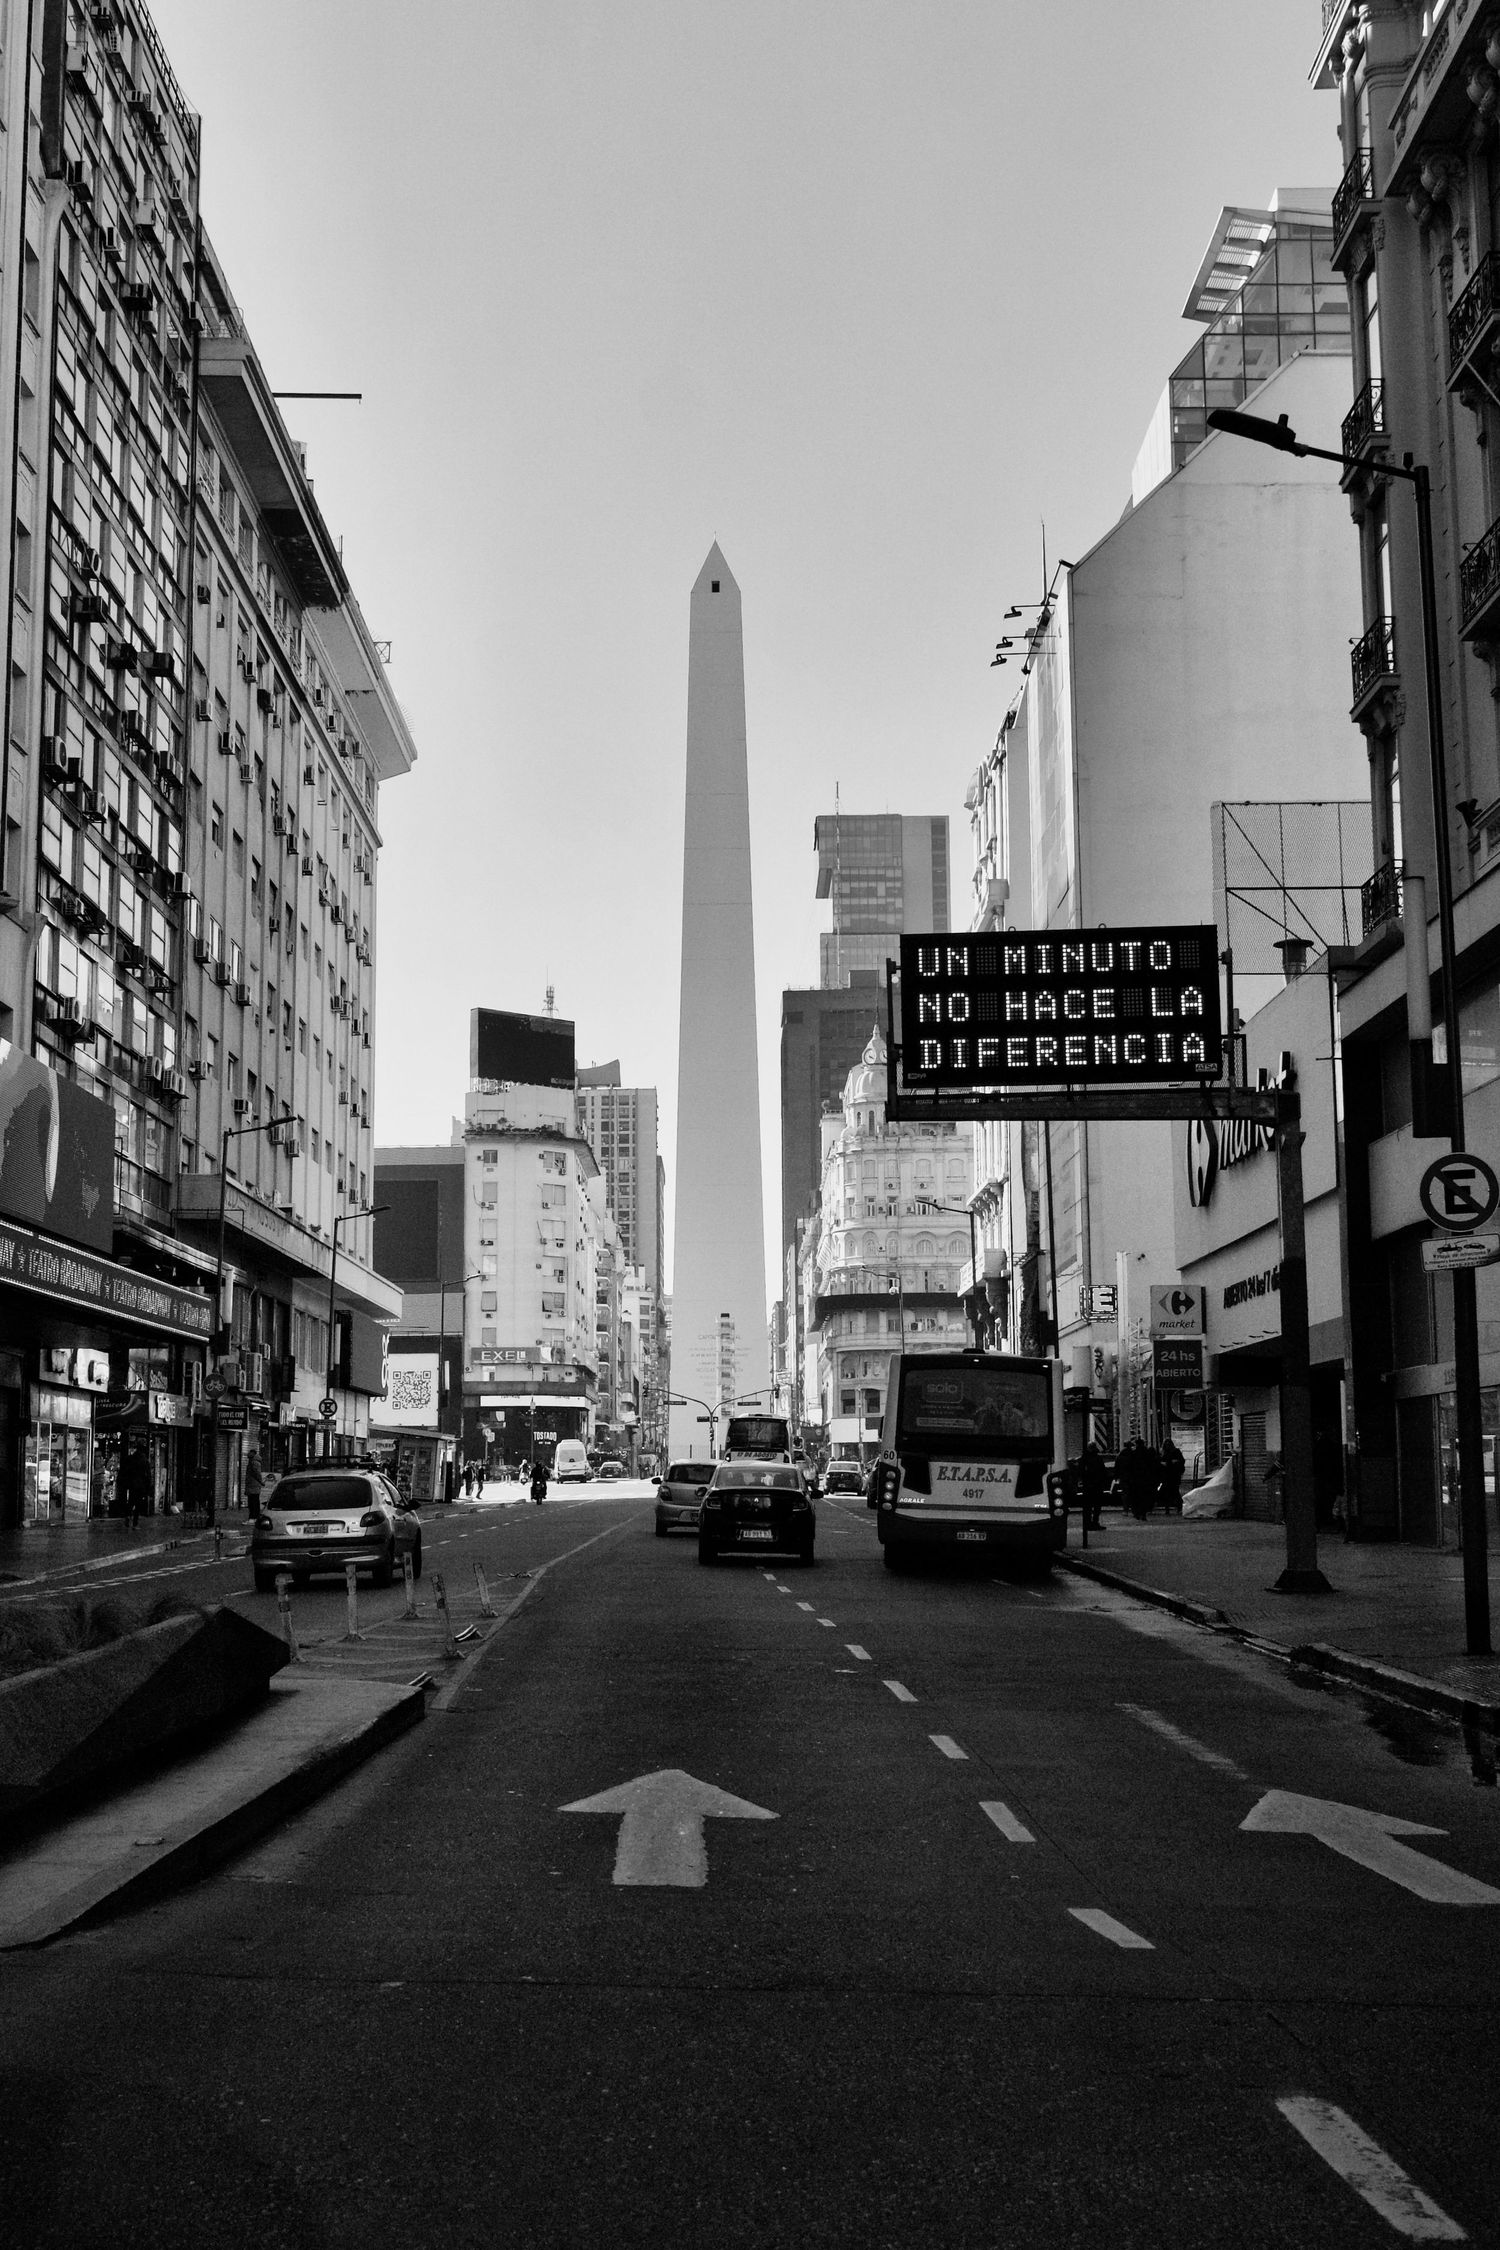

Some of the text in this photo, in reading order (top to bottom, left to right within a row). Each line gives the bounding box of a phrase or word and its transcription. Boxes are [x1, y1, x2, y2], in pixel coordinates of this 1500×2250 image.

[918, 940, 1172, 976] UN MINUTO
[918, 985, 1203, 1023] NO HACE LA
[919, 1032, 1205, 1069] DIFERENCIA
[29, 1248, 60, 1284] TEATRO
[60, 1257, 102, 1297] BROADWAY
[113, 1278, 137, 1308] TEATRO
[137, 1286, 171, 1319] BROADWAY
[1159, 1319, 1195, 1329] market
[1160, 1350, 1195, 1362] 24 hs
[1156, 1367, 1200, 1377] ABIERTO
[533, 1431, 557, 1442] TOSTADO
[883, 1450, 895, 1460] 60
[937, 1465, 1012, 1483] E.T.A.P.S.A.
[962, 1488, 985, 1499] 4917
